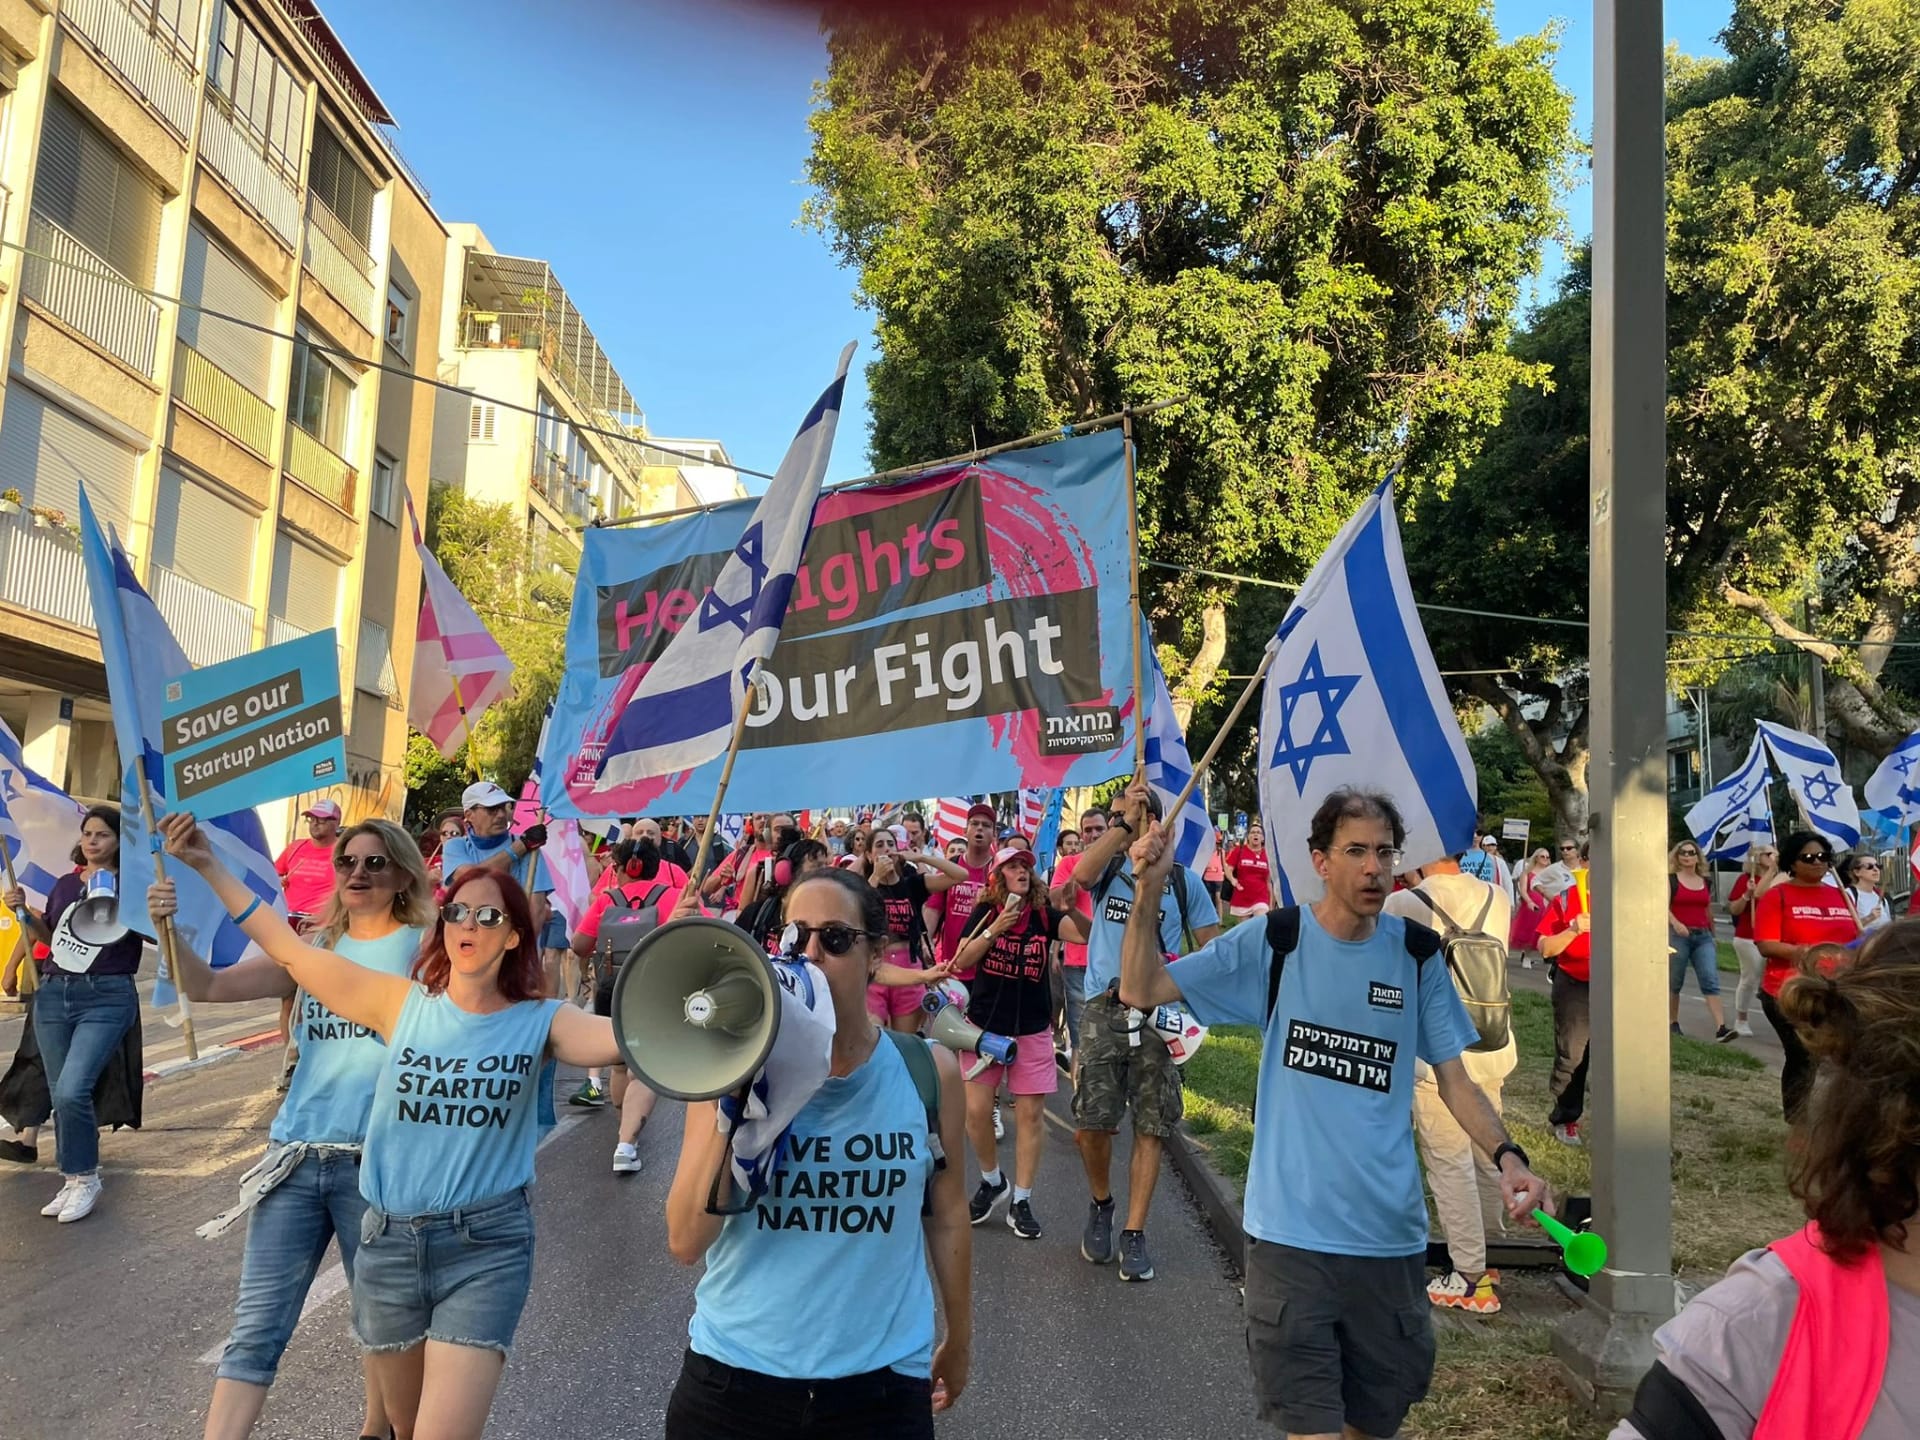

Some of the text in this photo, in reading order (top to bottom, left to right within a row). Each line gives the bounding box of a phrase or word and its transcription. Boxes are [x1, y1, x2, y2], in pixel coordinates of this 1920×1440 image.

[615, 518, 965, 651] He ights
[745, 615, 1064, 728] Our Fight
[176, 680, 291, 745] Save our
[1046, 711, 1113, 735] מחאת
[182, 716, 330, 785] Startup Nation
[1373, 987, 1402, 999] מחאת
[1292, 1024, 1393, 1059] אין דמוקרטיה
[397, 1047, 533, 1077] SAVE OUR
[1287, 1045, 1388, 1087] אין הייטק
[396, 1071, 521, 1101] STARTUP
[398, 1100, 512, 1129] NATION
[782, 1132, 916, 1163] VE OUR
[773, 1169, 907, 1199] TARTUP
[757, 1204, 895, 1234] NATION
